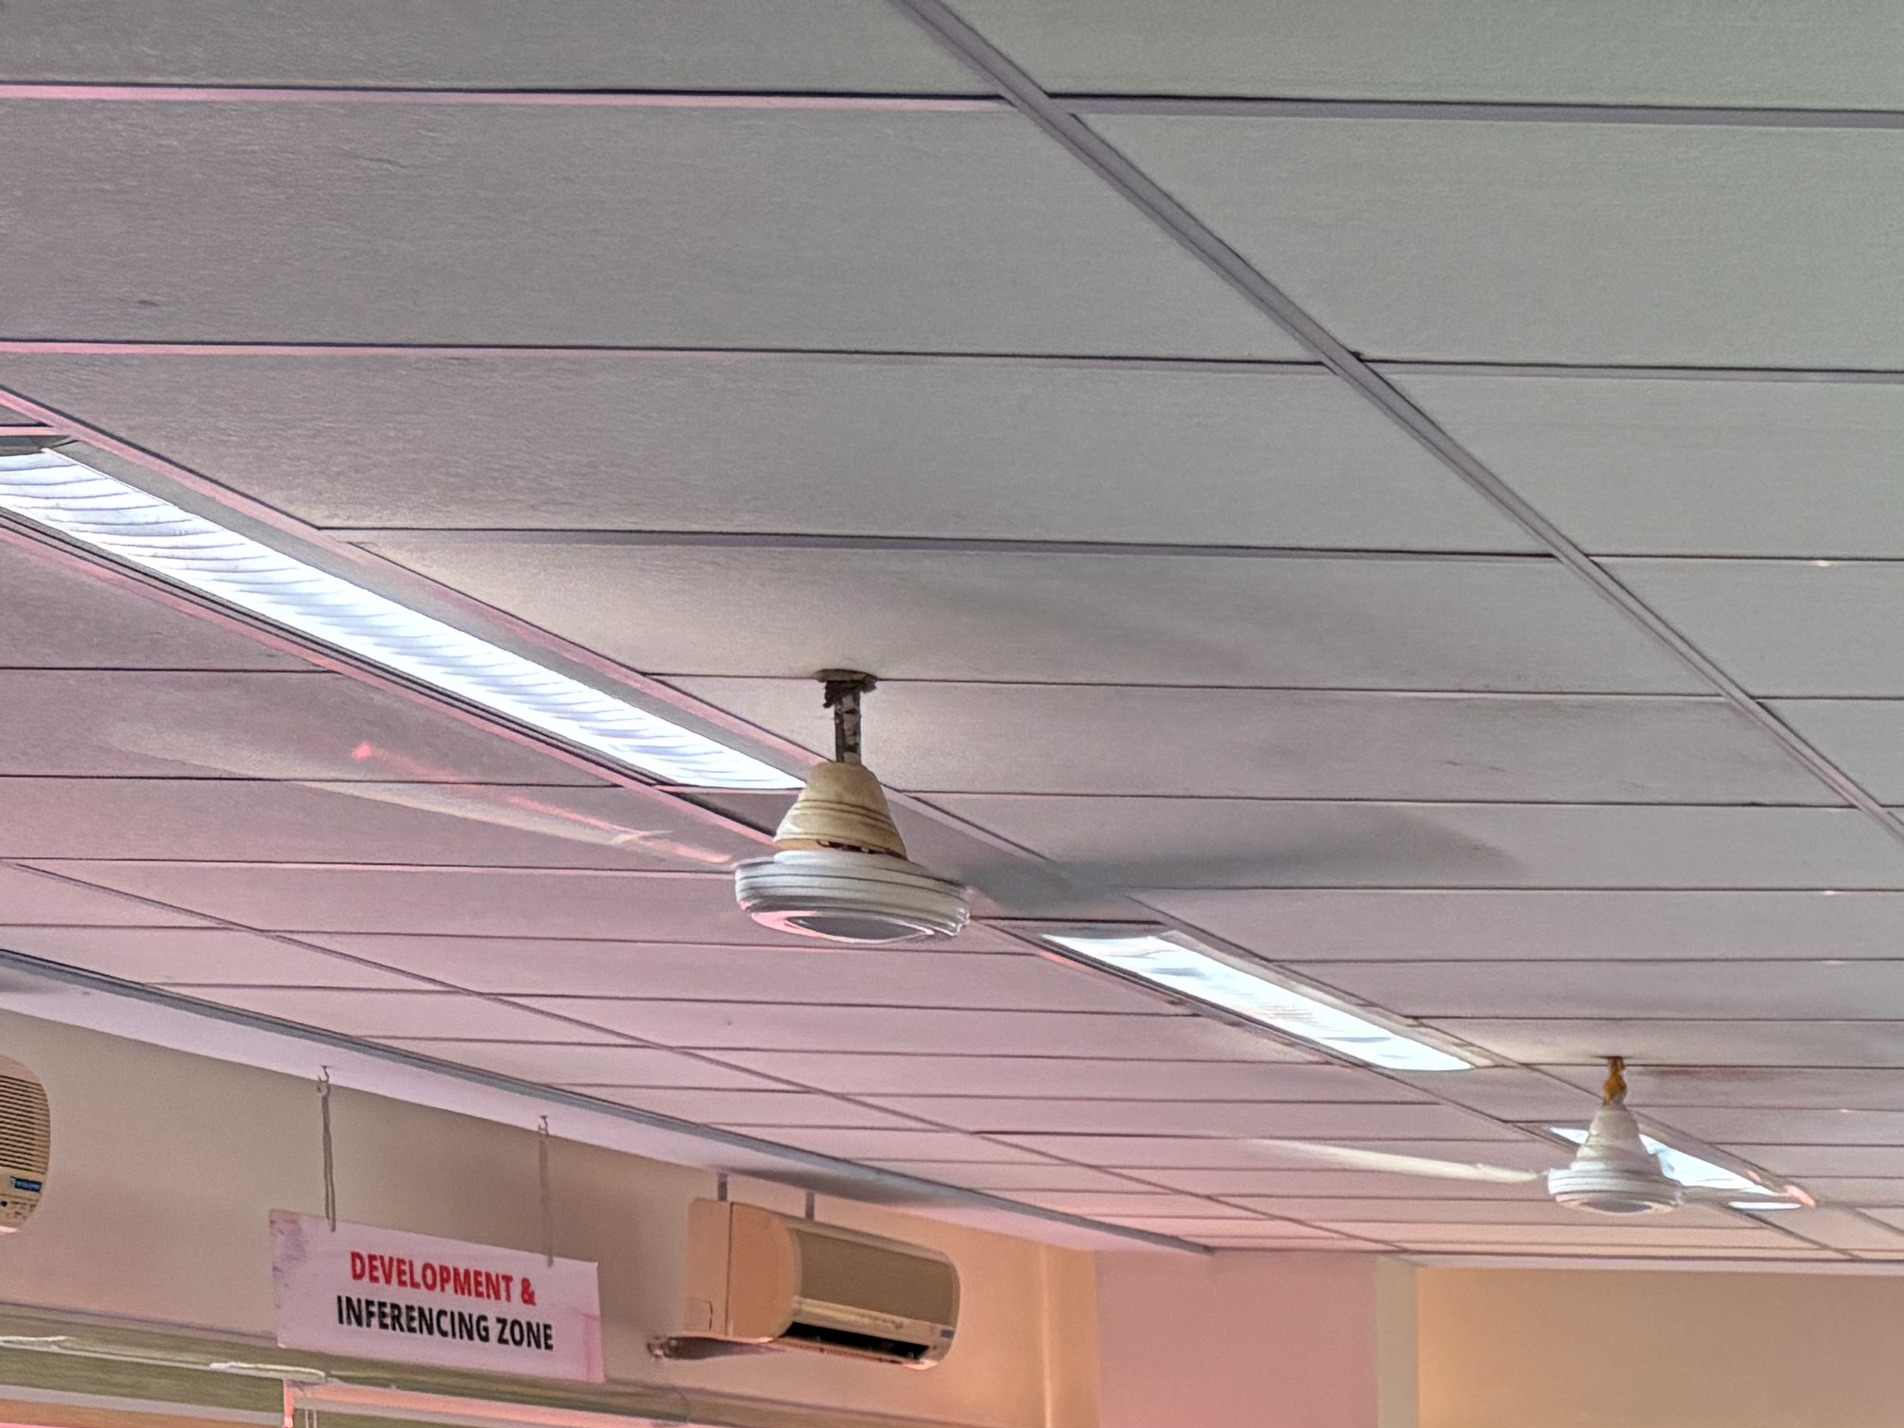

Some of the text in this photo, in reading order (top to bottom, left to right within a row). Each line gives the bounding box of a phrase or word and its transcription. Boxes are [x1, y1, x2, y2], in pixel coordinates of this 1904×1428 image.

[351, 1251, 536, 1306] DEVELOPMENT &
[337, 1295, 554, 1351] INFERENCING ZONE
